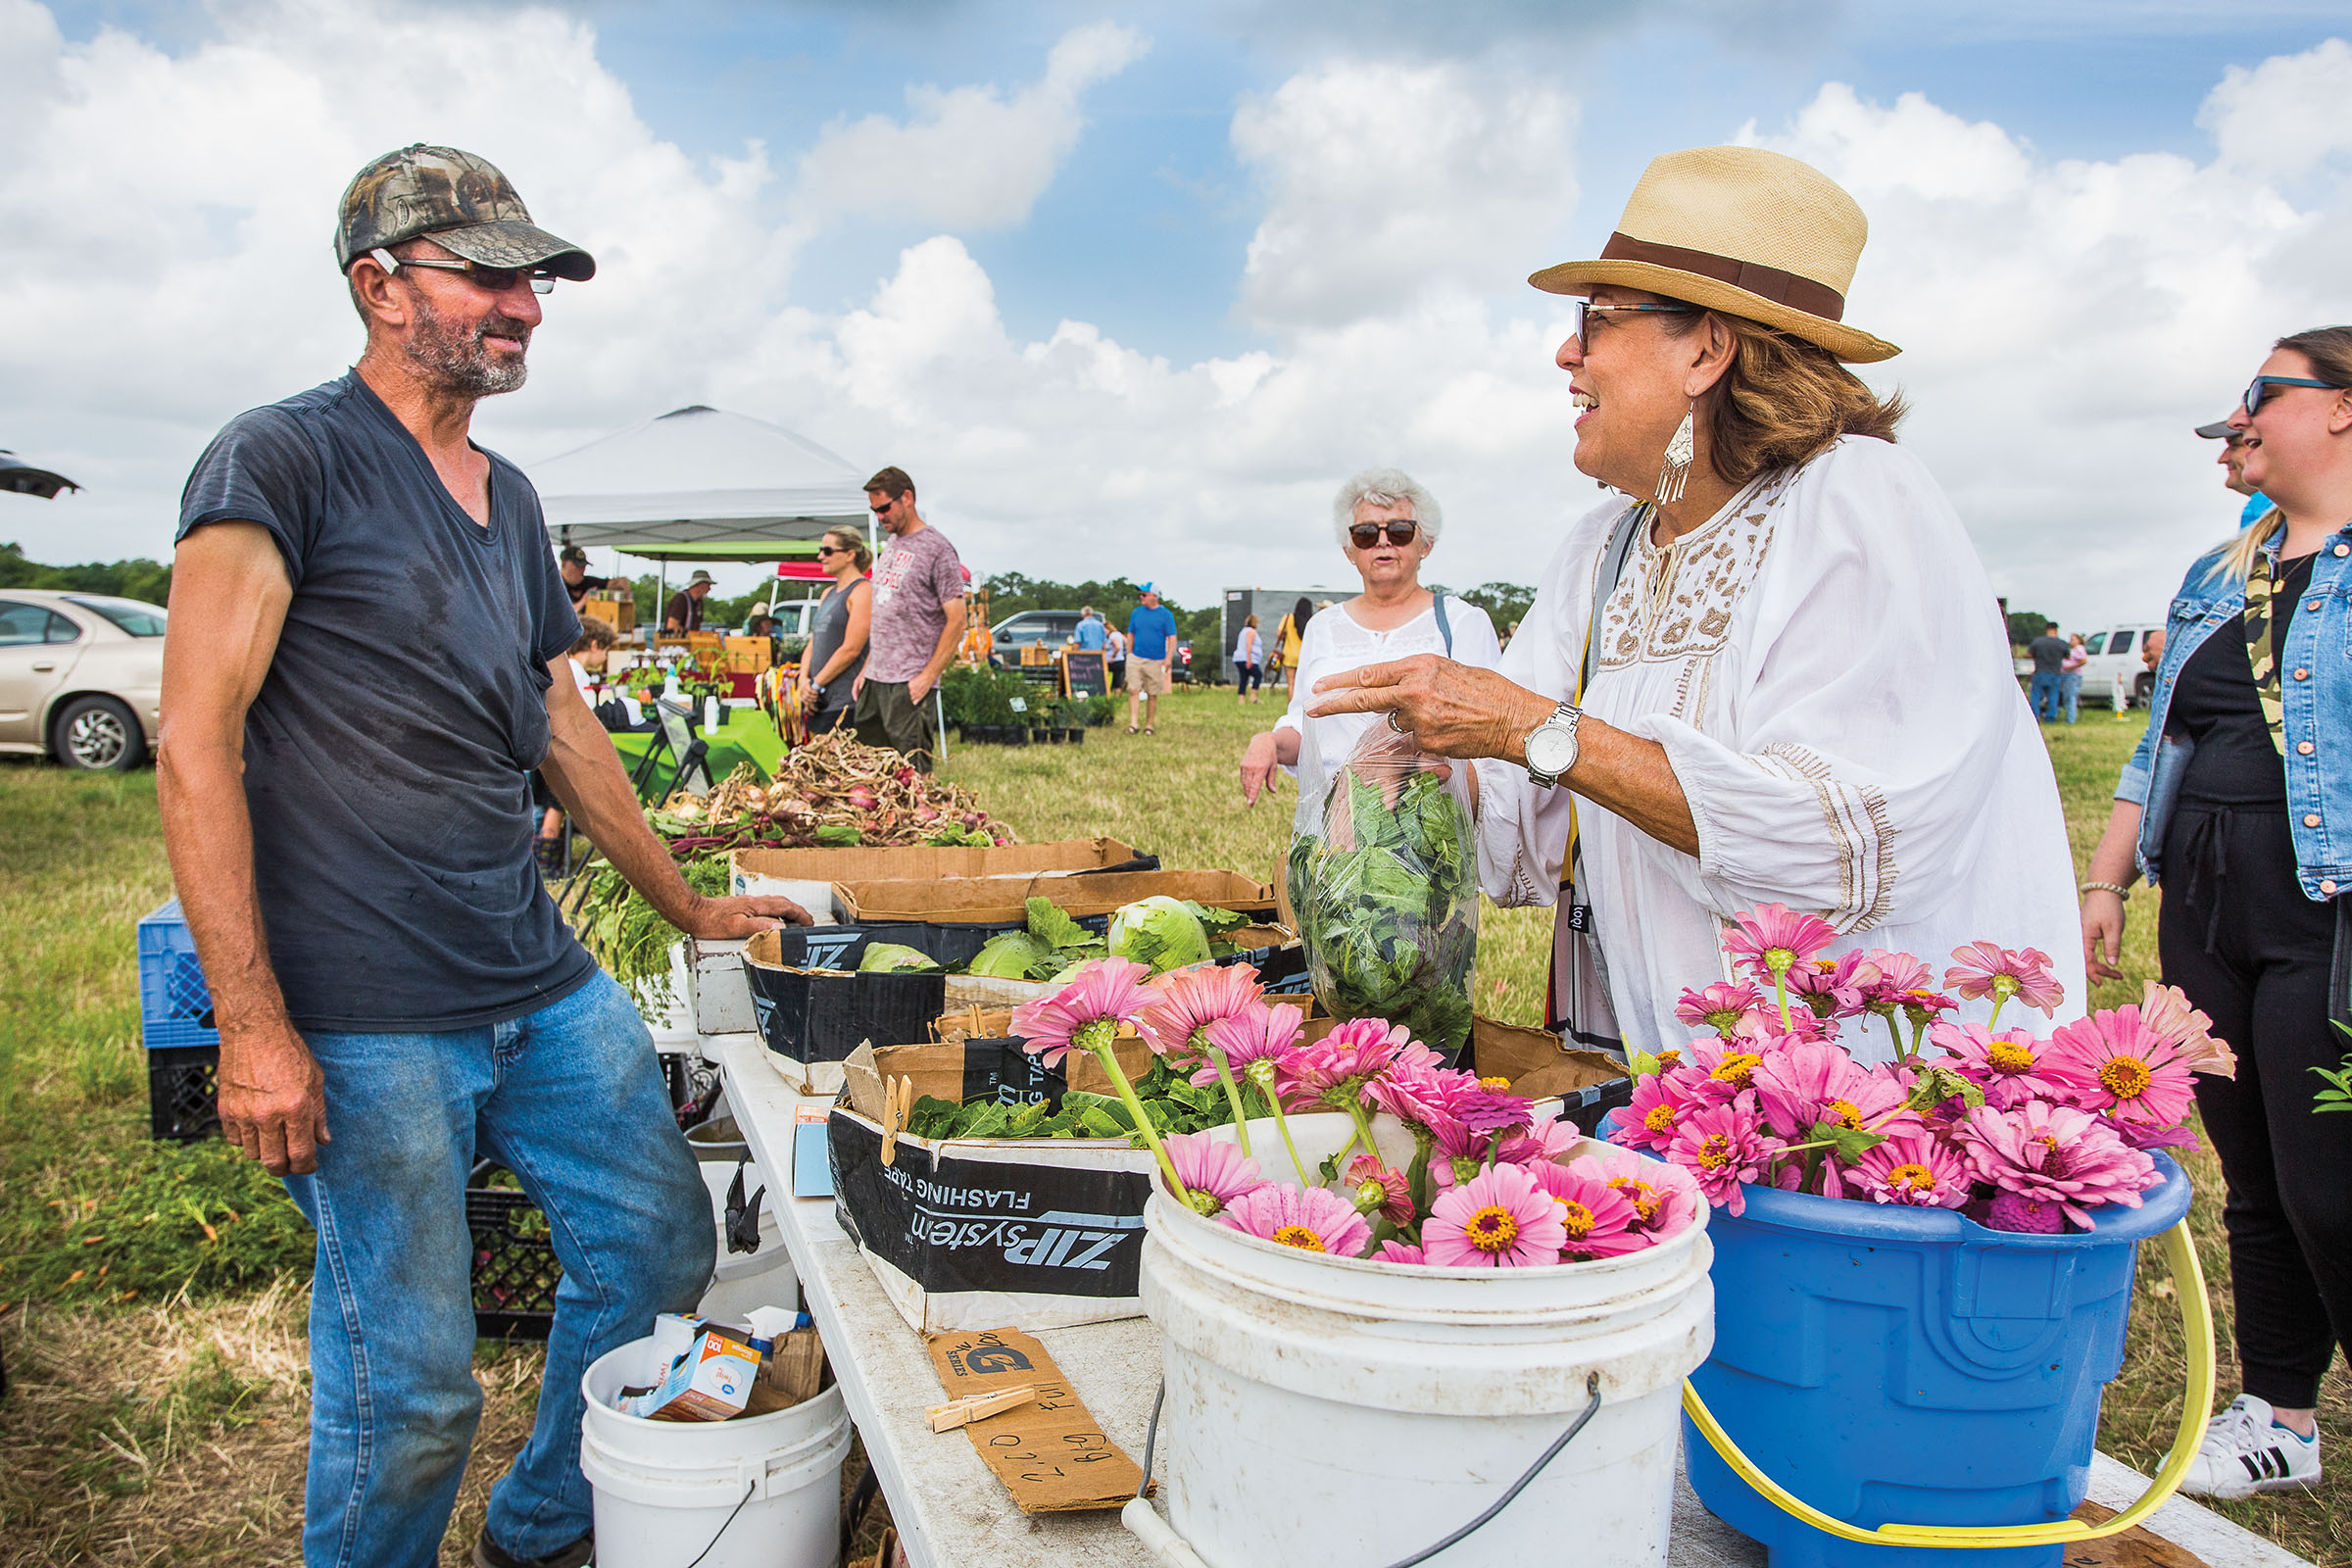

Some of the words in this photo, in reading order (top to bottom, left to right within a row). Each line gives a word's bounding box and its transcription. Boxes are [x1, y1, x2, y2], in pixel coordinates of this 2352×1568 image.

[915, 1182, 1031, 1210] FLASHING
[707, 1341, 721, 1352] 100
[946, 1349, 968, 1378] SERIES
